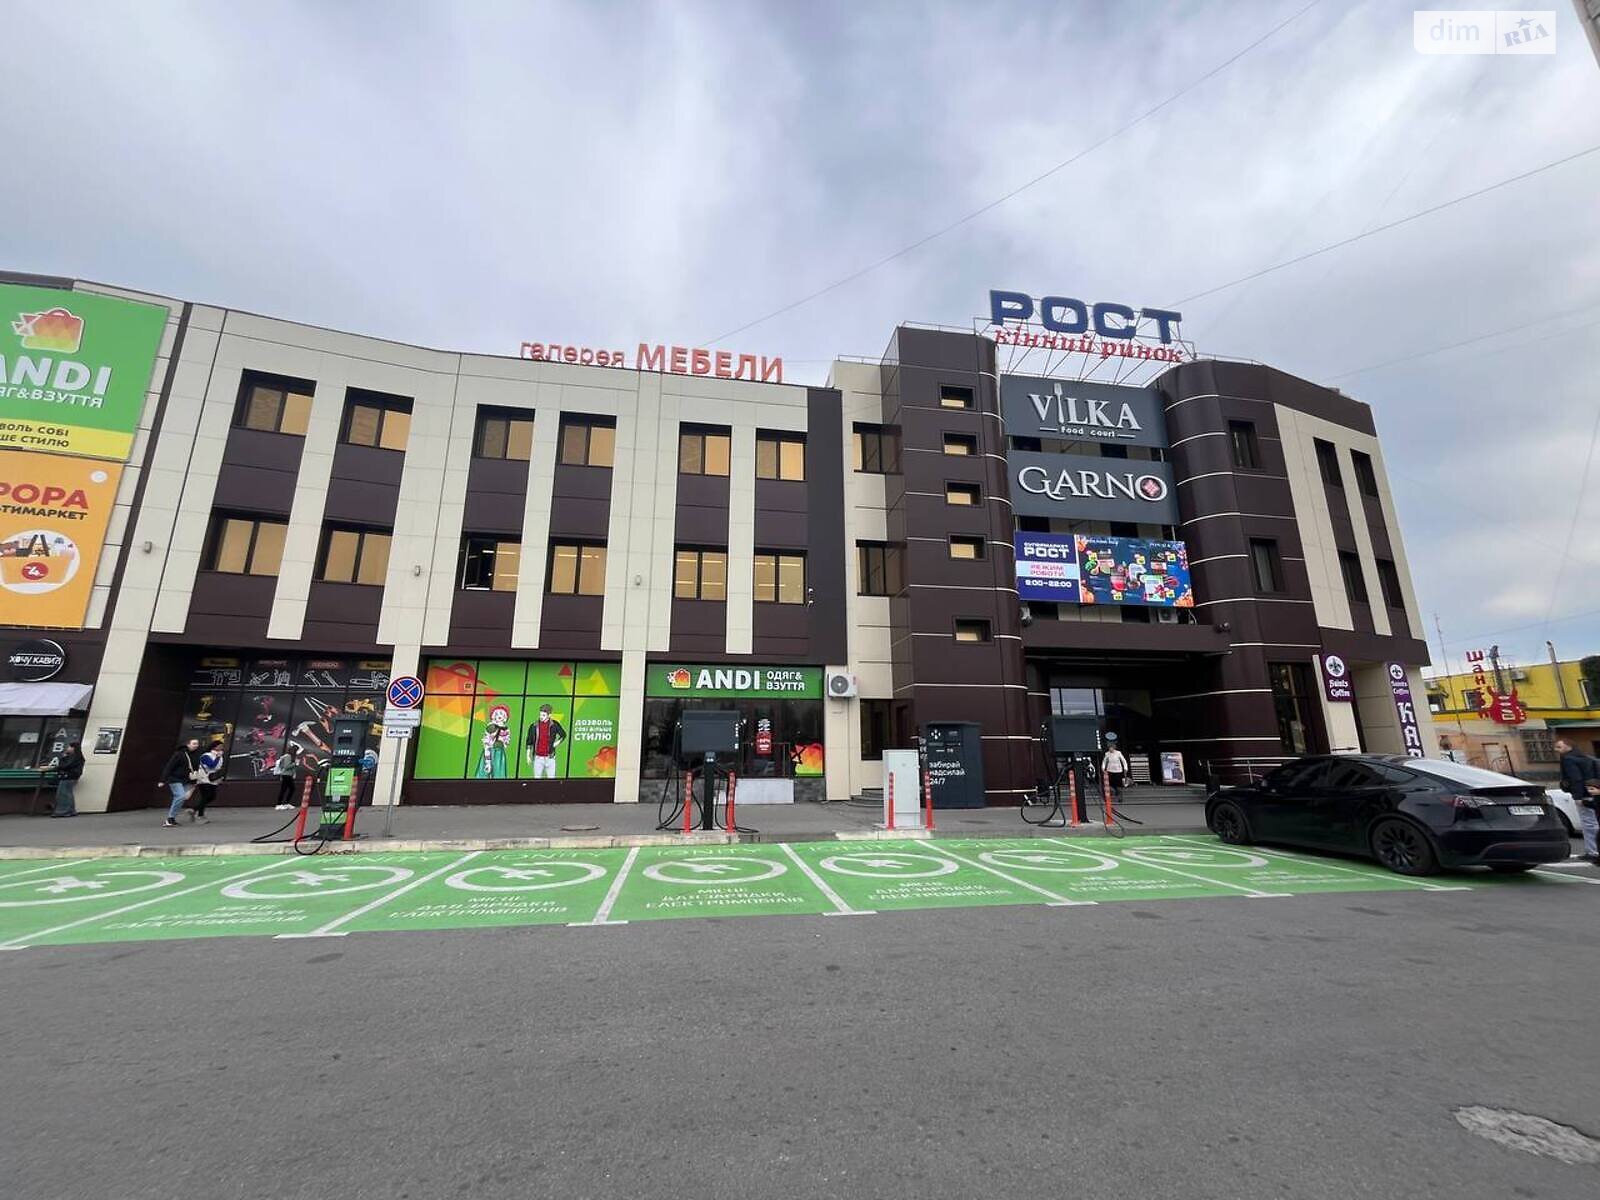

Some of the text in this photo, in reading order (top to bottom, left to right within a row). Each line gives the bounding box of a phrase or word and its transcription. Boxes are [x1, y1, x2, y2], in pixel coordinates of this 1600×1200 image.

[990, 290, 1182, 344] РОСТ
[1101, 341, 1183, 362] ринок
[637, 343, 783, 384] МЕБЕЛИ
[1028, 383, 1142, 430] VILKA
[38, 426, 69, 437] СОБІ
[1061, 426, 1084, 434] food
[21, 435, 70, 448] СТИЛЮ
[1018, 466, 1168, 501] GARNO
[0, 505, 88, 520] ТИМАРКЕТ
[1024, 547, 1070, 559] РОСТ
[696, 669, 760, 690] ANDI
[766, 681, 805, 691] ВЗУТТЯ
[575, 732, 612, 741] СТИЛЮ
